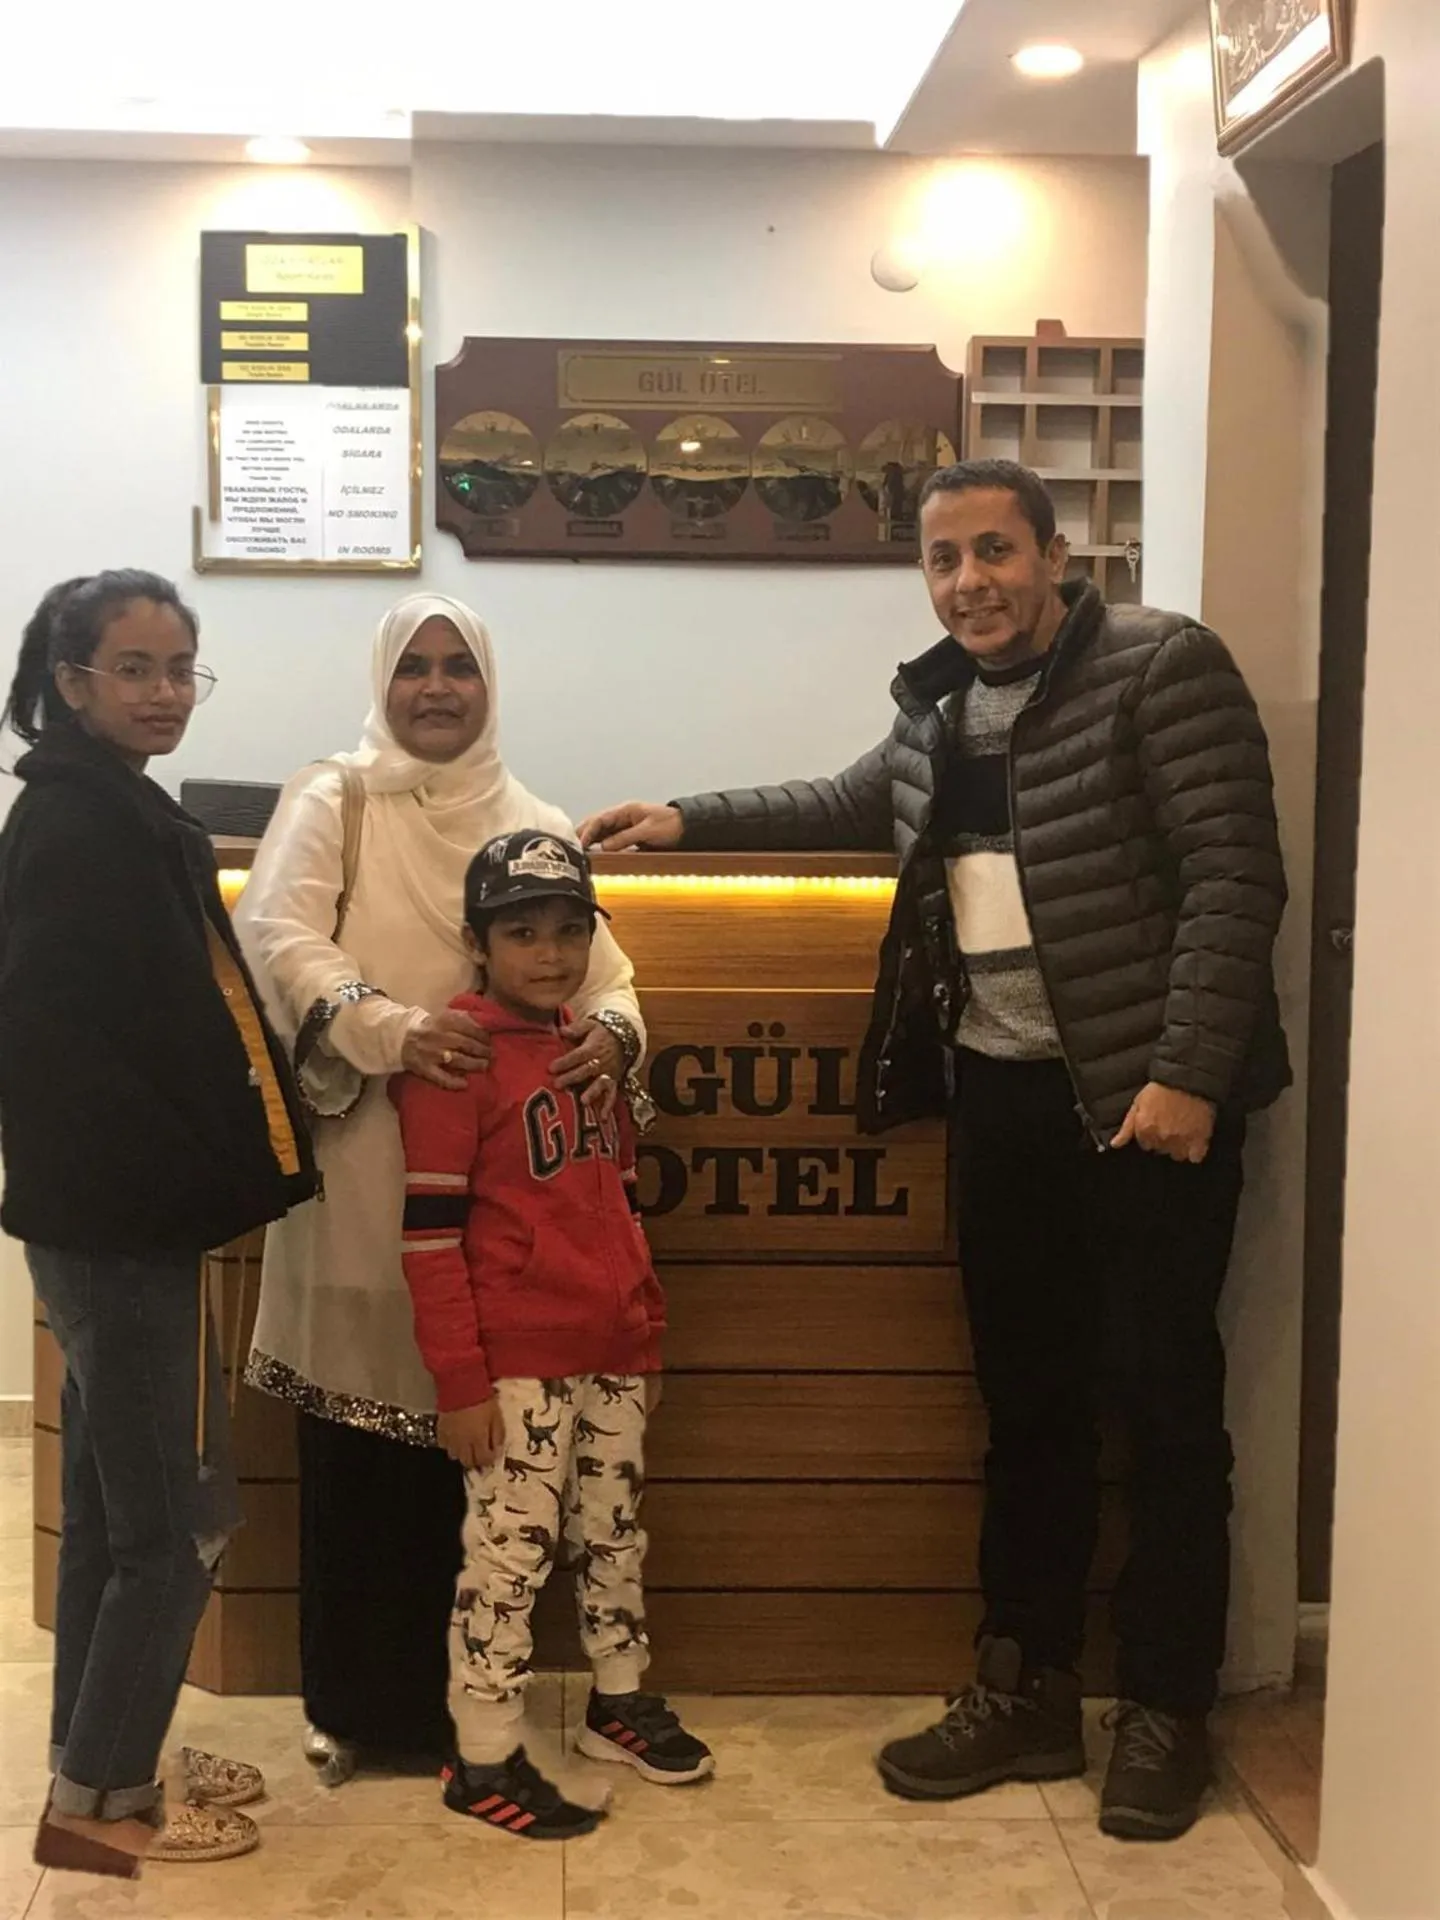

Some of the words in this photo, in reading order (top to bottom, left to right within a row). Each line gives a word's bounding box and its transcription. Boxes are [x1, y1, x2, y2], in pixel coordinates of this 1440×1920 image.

[637, 366, 688, 394] GÜL
[700, 371, 766, 395] OTEL
[649, 1021, 858, 1117] GÜL
[522, 1086, 620, 1181] GA
[625, 1145, 909, 1217] OTEL
